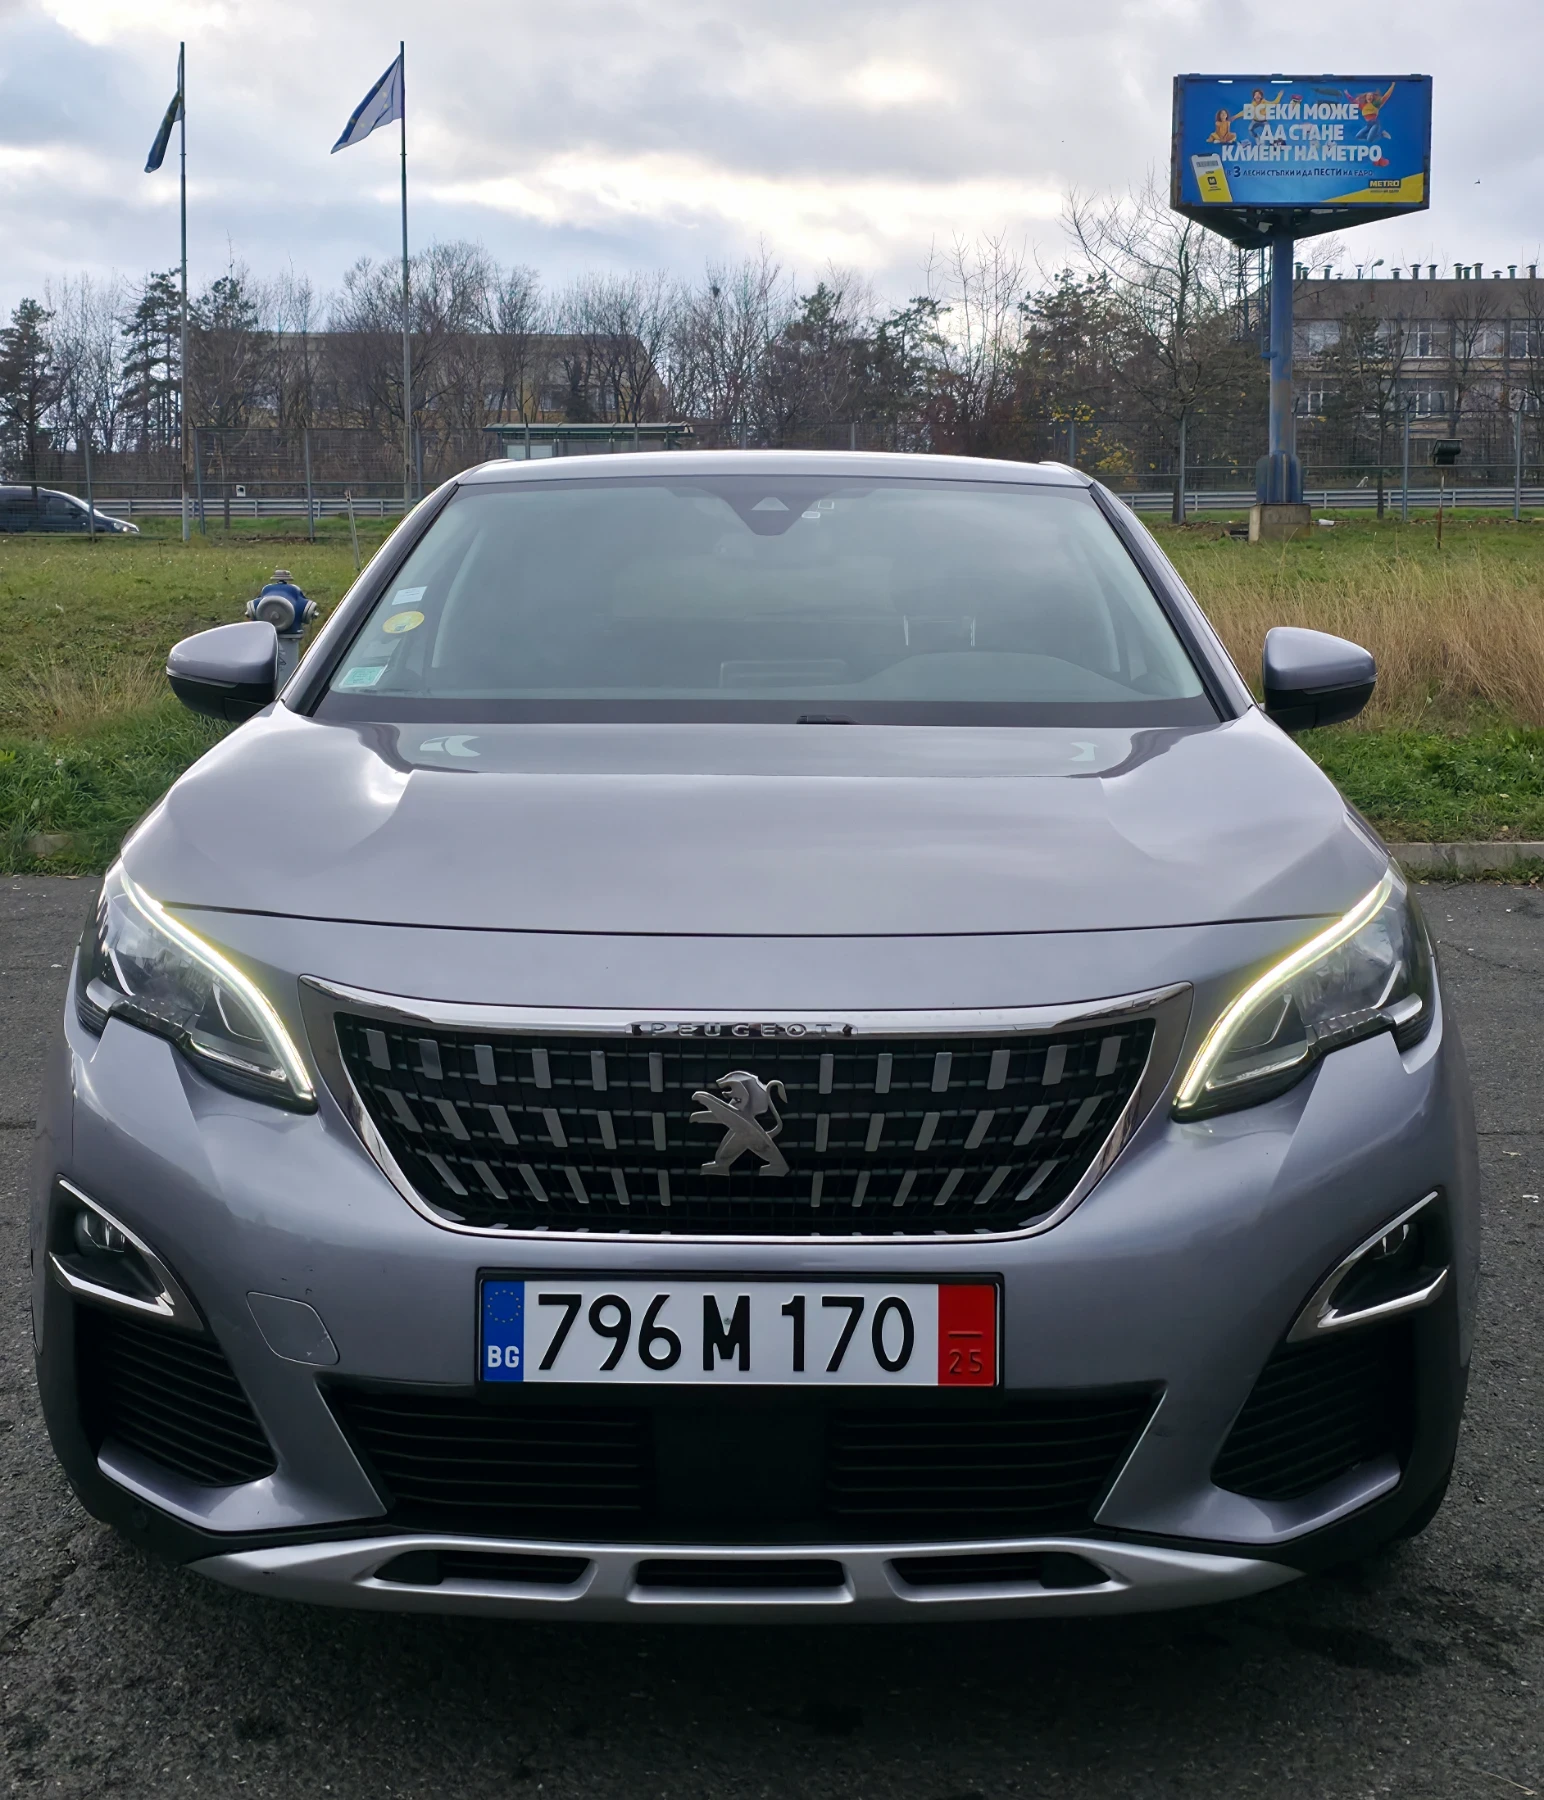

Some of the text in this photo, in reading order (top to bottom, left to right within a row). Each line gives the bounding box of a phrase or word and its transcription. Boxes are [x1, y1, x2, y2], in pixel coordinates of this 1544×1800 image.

[1243, 103, 1359, 120] ВСЕКИ МОЖЕ
[1260, 124, 1344, 141] ДА СТАНЕ
[1222, 145, 1383, 161] КЛИЕНТ НА МЕТРО
[1233, 165, 1241, 178] 3
[1266, 169, 1295, 177] СТЪПКИ
[1302, 169, 1312, 177] ДА
[1313, 168, 1342, 177] ПЕСТИ
[1370, 180, 1400, 188] METRO
[651, 1022, 832, 1037] PEUGEOT
[538, 1293, 915, 1372] 796 M 170
[487, 1345, 520, 1368] BG
[949, 1348, 983, 1374] 25
